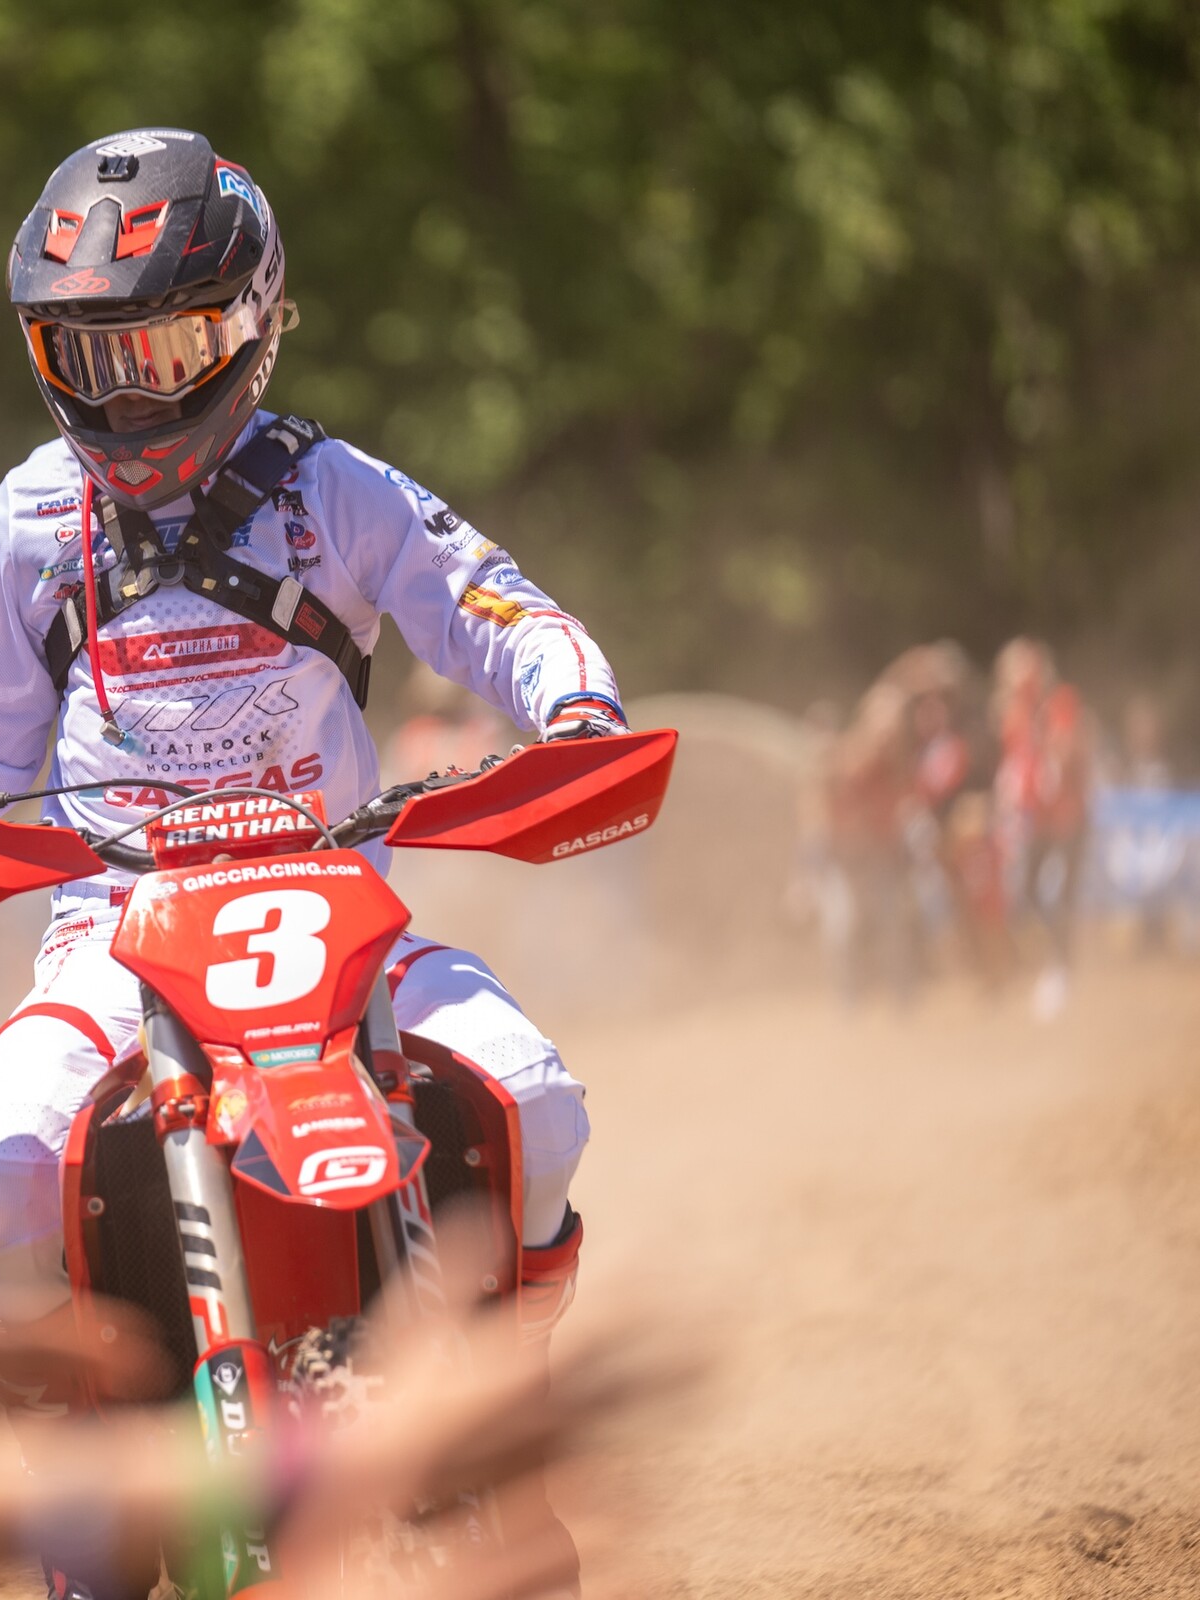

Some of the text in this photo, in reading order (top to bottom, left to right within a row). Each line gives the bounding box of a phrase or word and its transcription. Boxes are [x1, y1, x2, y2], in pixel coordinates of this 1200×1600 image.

[53, 556, 100, 576] MOTORX
[178, 639, 212, 655] ALPHA
[217, 636, 237, 650] ONE
[150, 729, 272, 755] LATROCK
[146, 752, 264, 772] MOTORCLUB
[162, 793, 313, 827] RENTHAL
[166, 813, 316, 848] RENTHAL
[552, 813, 649, 857] GASGAS
[205, 889, 331, 1010] 3
